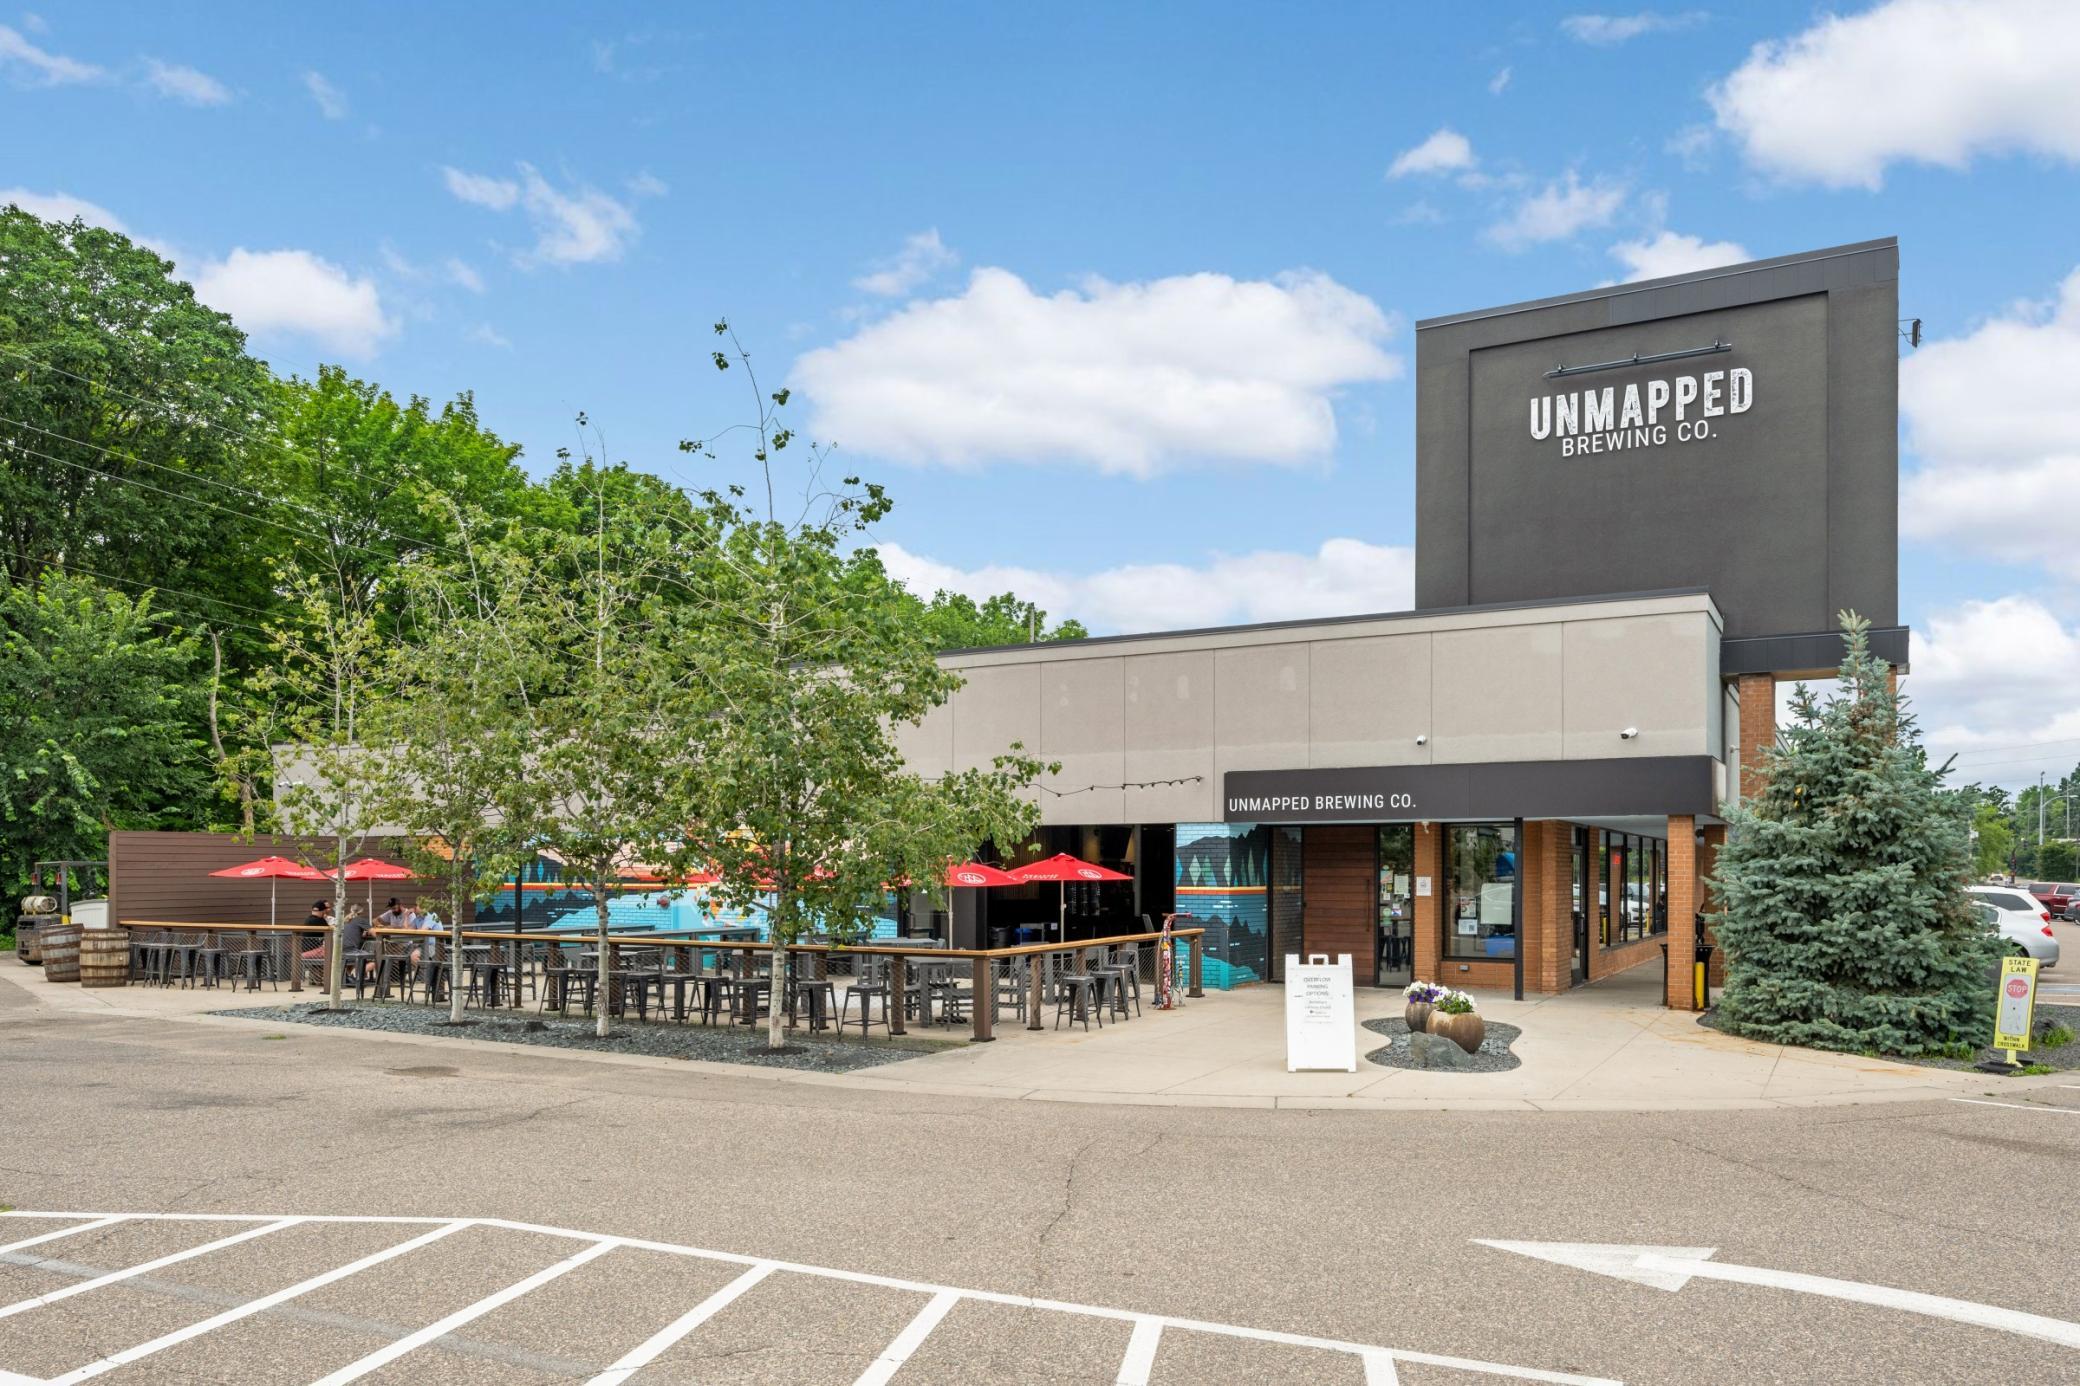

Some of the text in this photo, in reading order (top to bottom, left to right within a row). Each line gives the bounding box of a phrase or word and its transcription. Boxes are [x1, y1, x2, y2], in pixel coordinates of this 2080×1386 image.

[1530, 367, 1753, 440] UNMAPPED
[1562, 420, 1718, 457] BREWING CO.
[1229, 793, 1417, 812] UNMAPPED BREWING CO.
[2008, 985, 2027, 993] STOP
